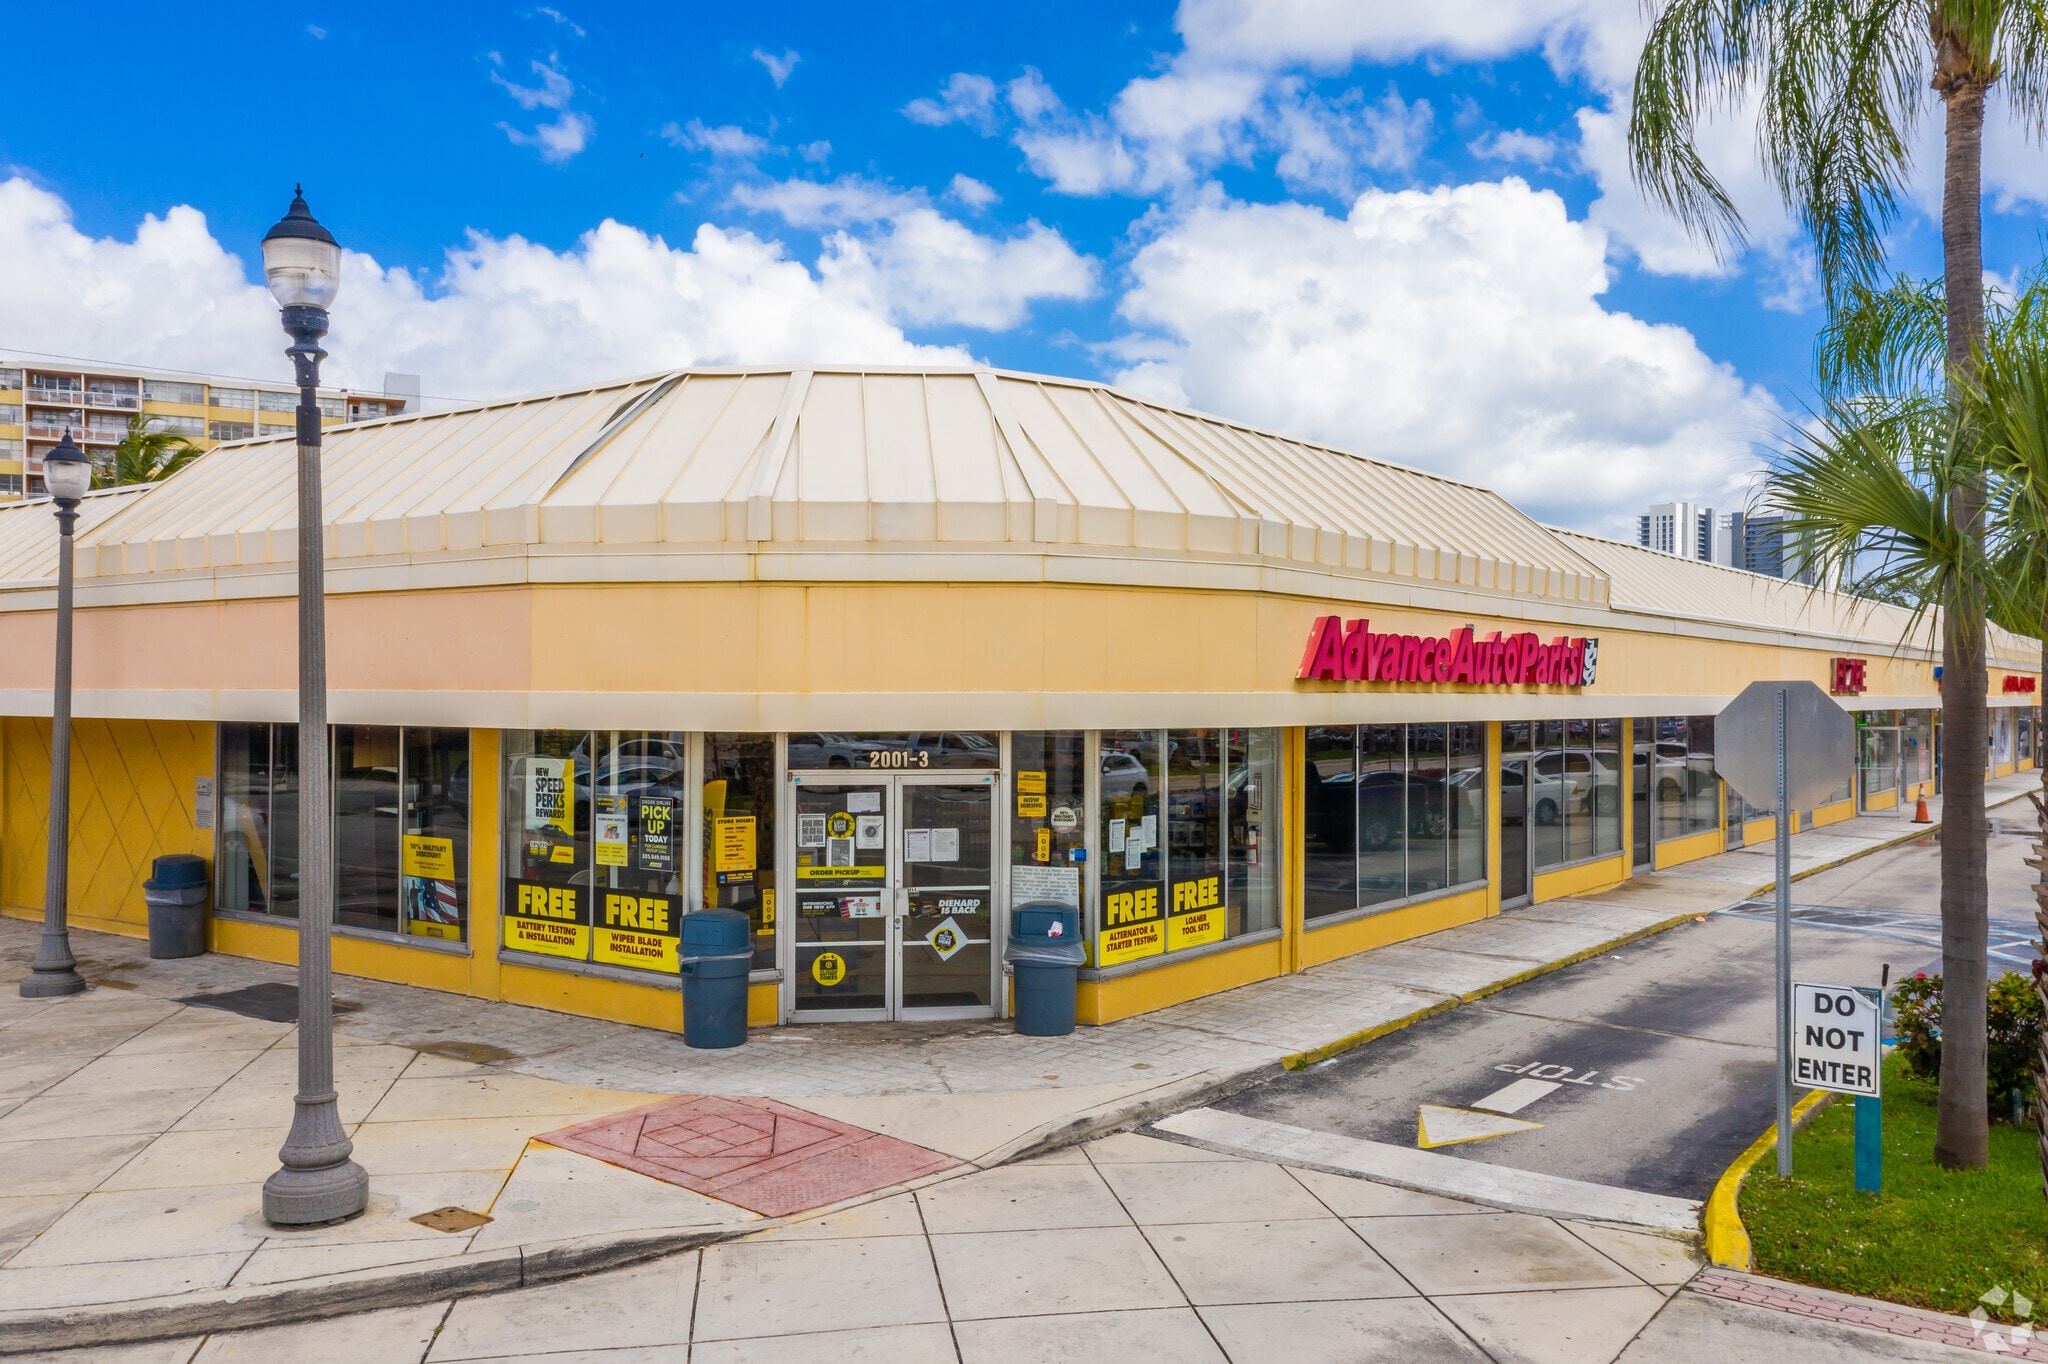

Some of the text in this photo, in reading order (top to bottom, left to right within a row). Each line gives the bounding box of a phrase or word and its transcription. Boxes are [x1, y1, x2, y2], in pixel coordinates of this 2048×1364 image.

[869, 750, 929, 768] 2001-3
[535, 767, 549, 777] NEW
[535, 778, 565, 794] SPEED
[535, 793, 565, 809] PERKS
[535, 808, 565, 819] REWARDS
[641, 805, 671, 820] PICK
[648, 820, 665, 834] UP
[645, 834, 668, 844] TODAY
[416, 850, 441, 859] DISCOUNT
[423, 844, 447, 853] MILITARY
[518, 884, 576, 920] FREE
[1174, 877, 1218, 912] FREE
[938, 899, 981, 908] DIEHARD
[941, 906, 976, 915] IS BACK
[1107, 887, 1158, 926] FREE
[606, 894, 669, 932] FREE
[1185, 914, 1207, 925] LOANER
[517, 921, 576, 936] BATTERY TESTING
[1109, 925, 1155, 941] ALTERNATOR &
[1182, 923, 1210, 935] TOOL SETS
[518, 931, 524, 939] &
[526, 932, 575, 946] INSTALLATION
[611, 933, 662, 948] WIPER BLADE
[1106, 940, 1133, 952] STARTER
[1134, 934, 1158, 947] TESTING
[610, 943, 663, 958] INSTALLATION
[1814, 992, 1856, 1017] DO
[1806, 1025, 1865, 1052] NOT
[1494, 1061, 1646, 1091] STOP
[1798, 1057, 1872, 1088] ENTER
